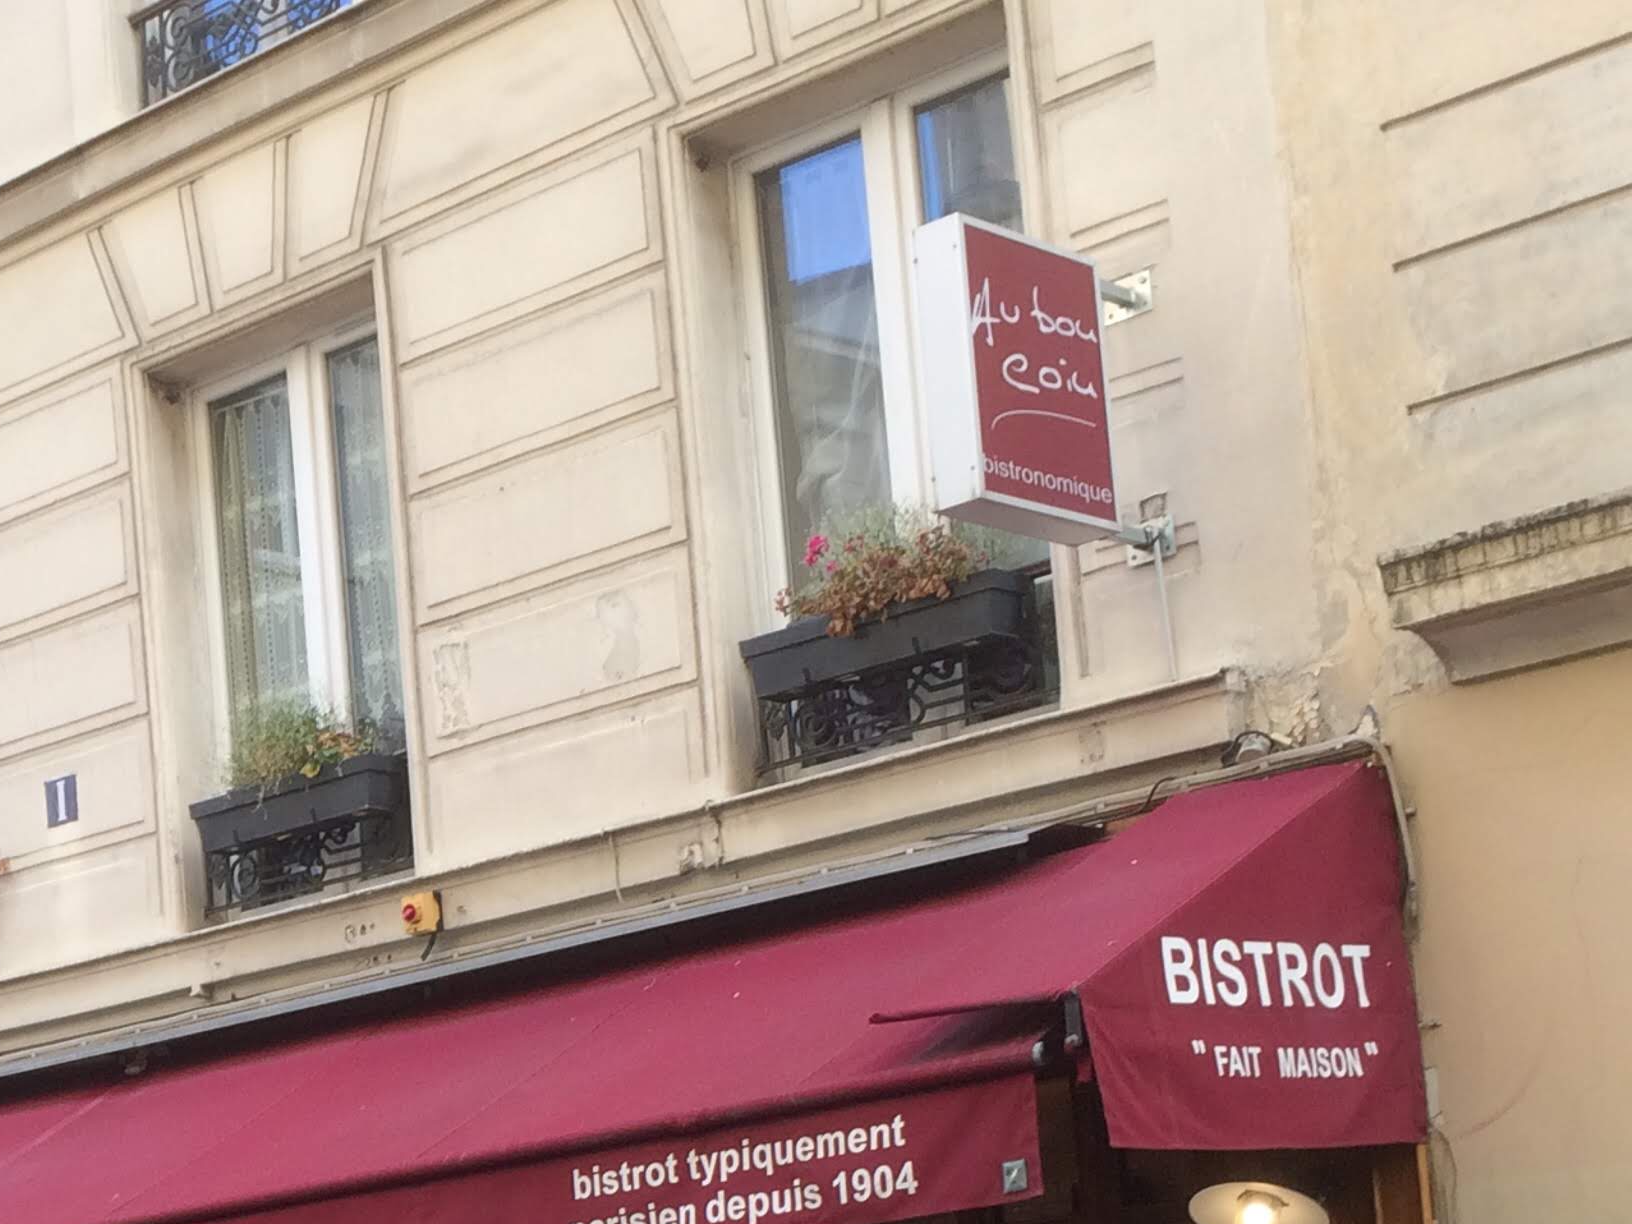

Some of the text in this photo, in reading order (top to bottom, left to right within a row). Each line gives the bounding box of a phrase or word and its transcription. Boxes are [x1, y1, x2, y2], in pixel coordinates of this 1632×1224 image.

[971, 278, 1020, 346] Au
[983, 454, 1113, 504] bistronomique
[1161, 936, 1371, 1009] BISTROT
[572, 1113, 907, 1200] bistrot typiquement
[832, 1159, 920, 1206] 1904
